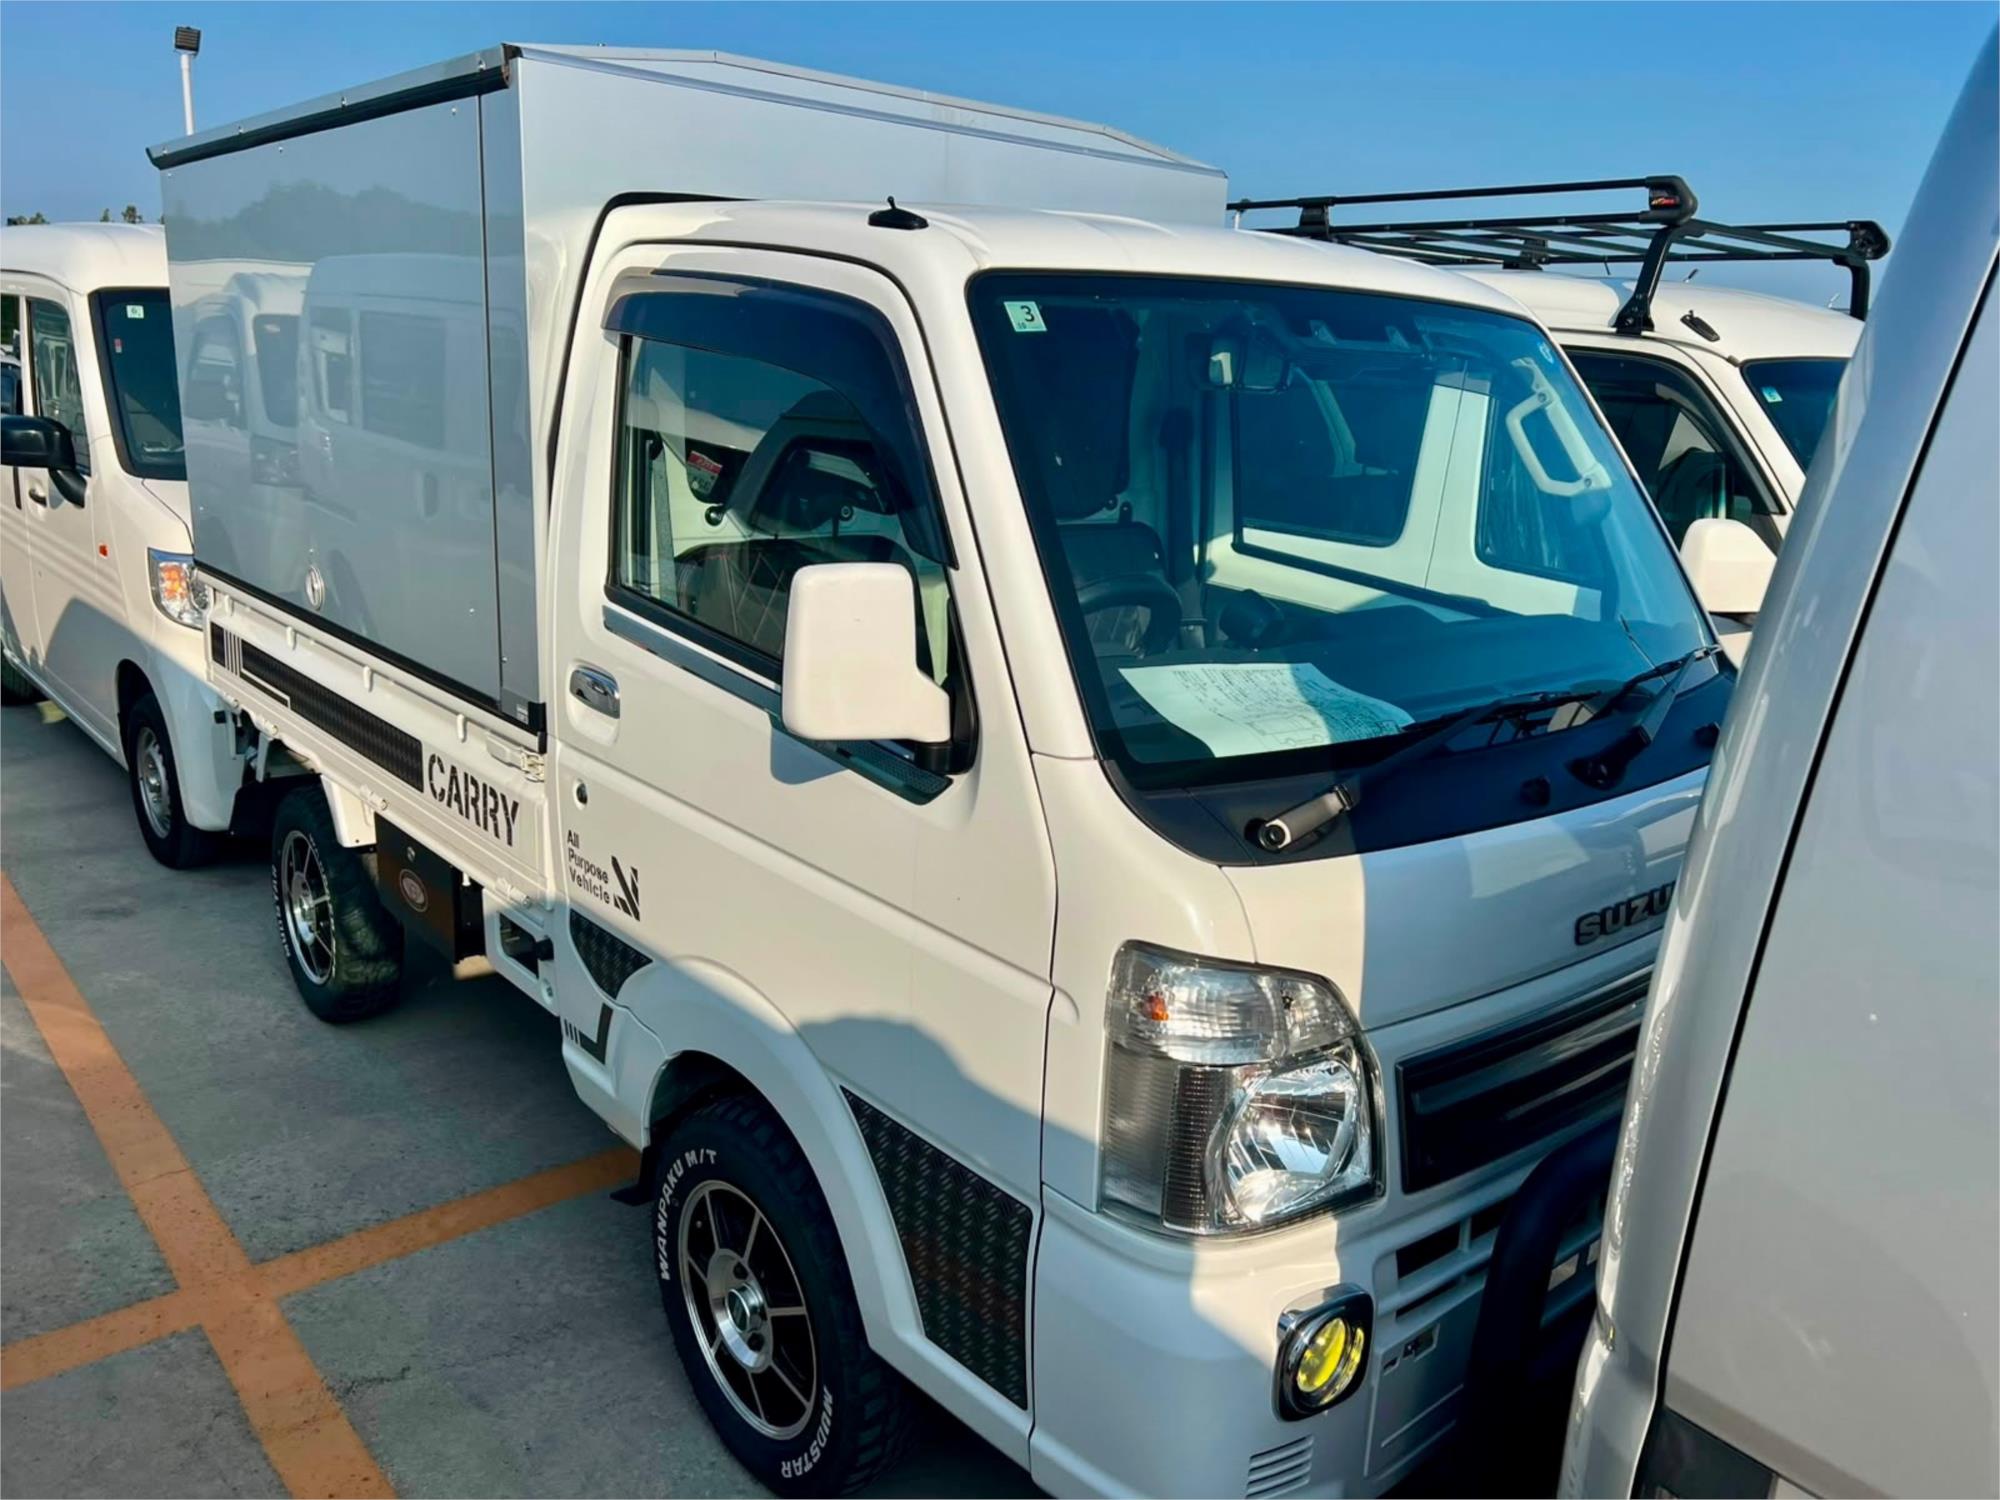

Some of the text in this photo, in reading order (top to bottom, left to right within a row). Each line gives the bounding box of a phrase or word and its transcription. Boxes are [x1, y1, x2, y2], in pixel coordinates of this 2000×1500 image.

[1020, 305, 1035, 322] 3
[428, 754, 519, 847] CARRY
[567, 829, 580, 849] All
[568, 847, 609, 884] Purpose
[569, 866, 610, 904] Vehicle
[657, 1148, 717, 1280] WANPAKU M/T
[781, 1384, 833, 1478] MUDSTAR
